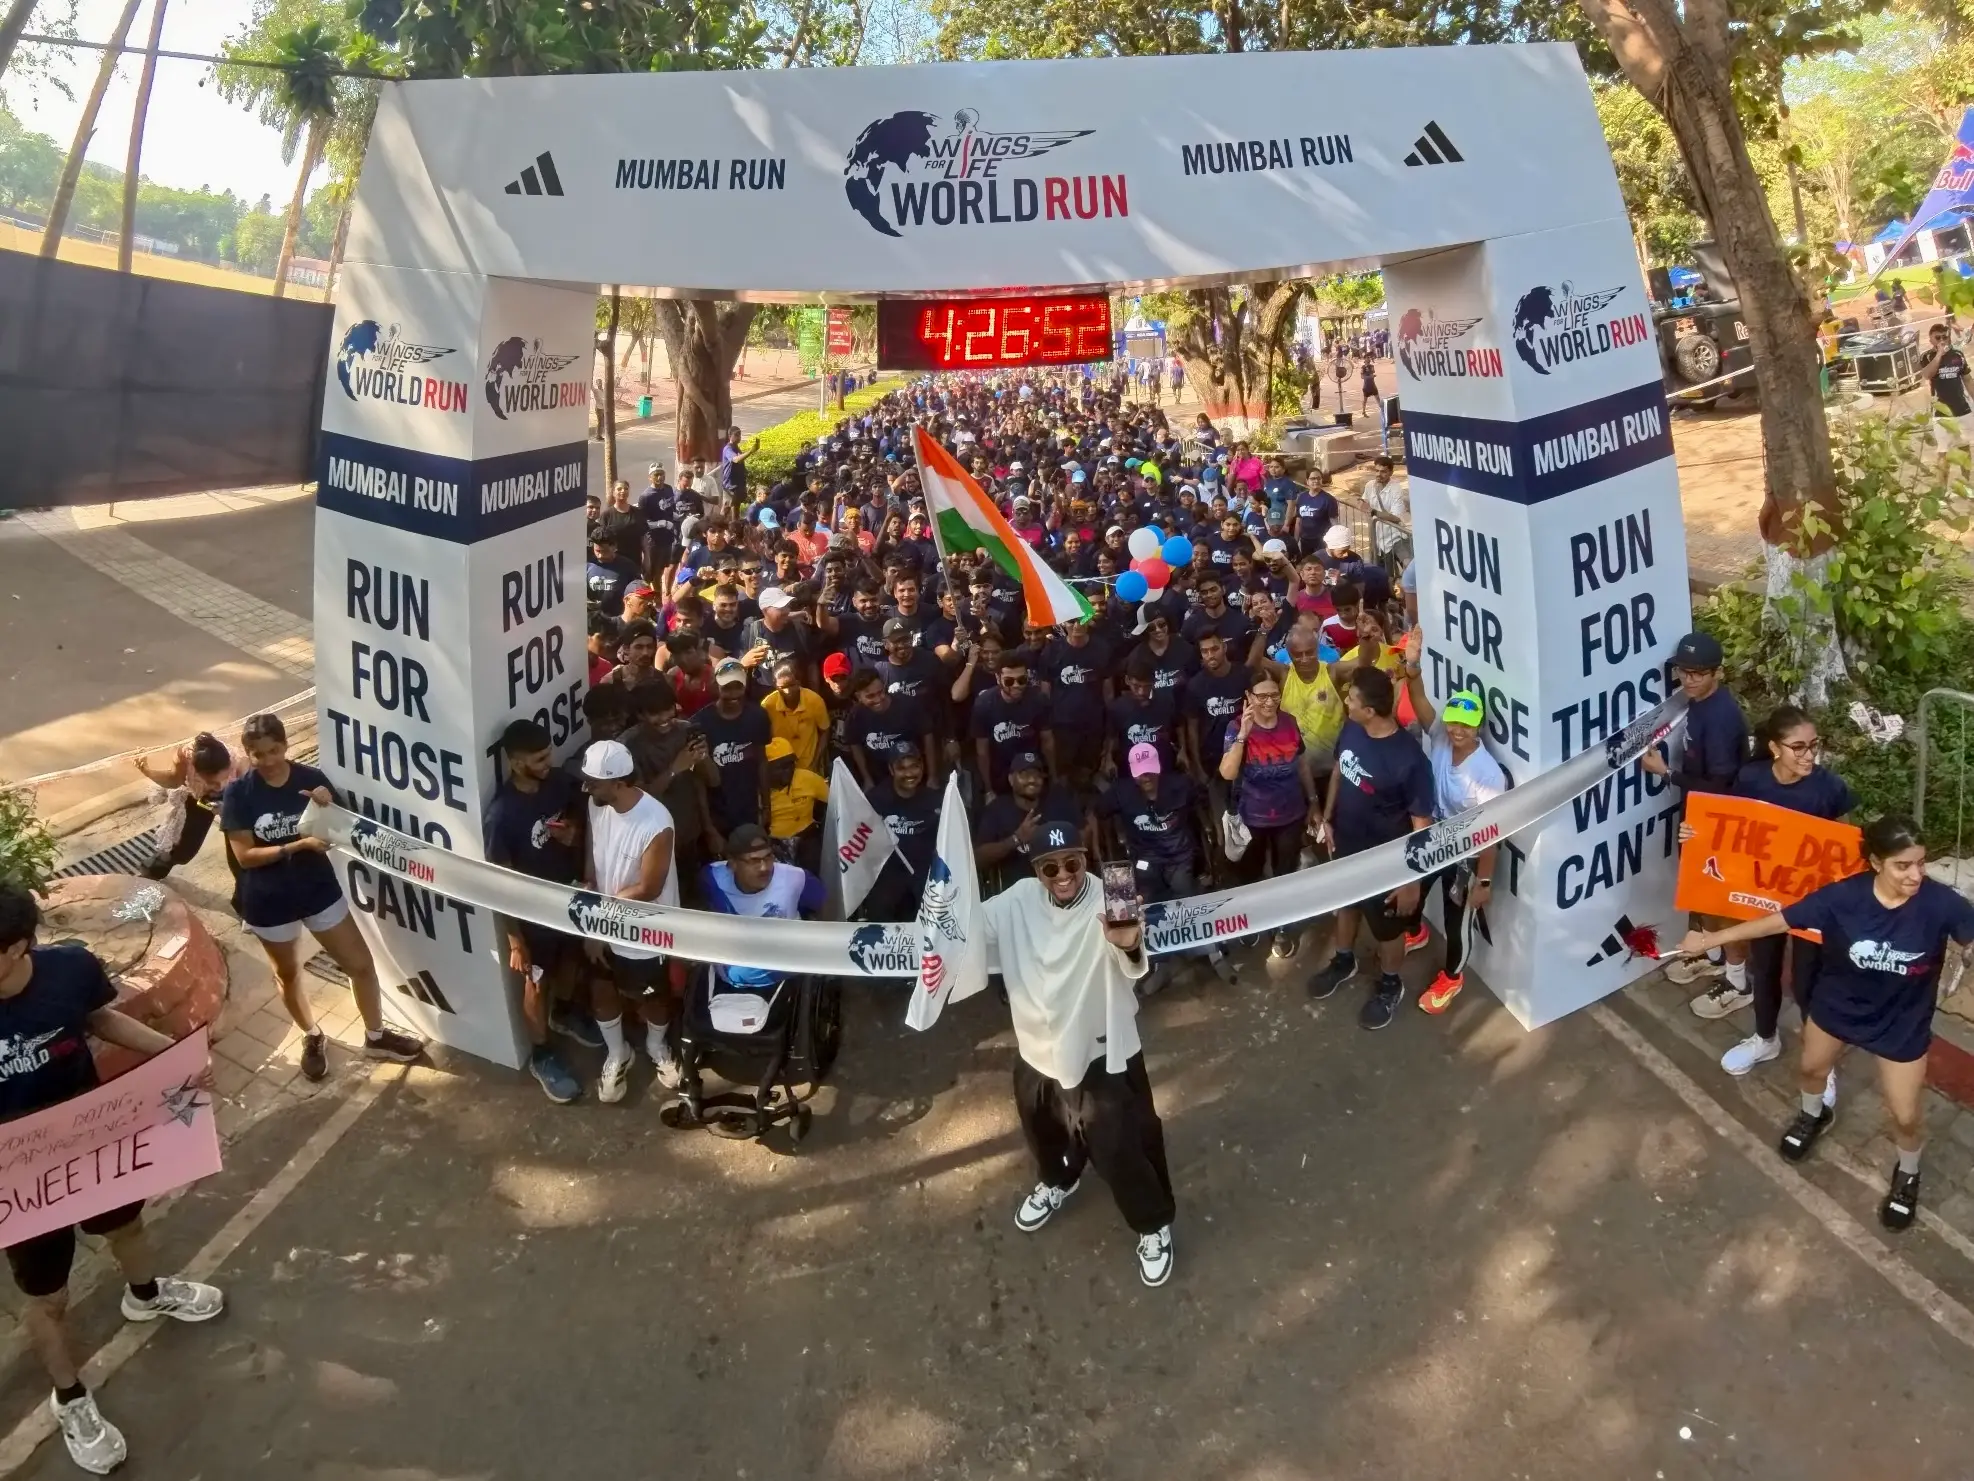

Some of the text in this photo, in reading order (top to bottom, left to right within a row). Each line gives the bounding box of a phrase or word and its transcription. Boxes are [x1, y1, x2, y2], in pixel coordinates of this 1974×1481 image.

[931, 134, 1031, 158] WINGS
[1181, 134, 1354, 176] MUMBAI RUN
[615, 158, 786, 190] MUMBAI RUN
[925, 158, 1003, 179] FOR LIFE
[1931, 168, 1974, 192] Bull
[891, 174, 1129, 226] WORLD RUN
[1553, 294, 1600, 318] WINGS
[1563, 314, 1589, 331] LIFE
[375, 340, 423, 360] WINGS
[1540, 313, 1648, 368] WORLD RUN
[522, 354, 559, 370] WINGS
[1413, 348, 1504, 378] WORLD RUN
[355, 366, 468, 414] WORLD RUN
[505, 382, 586, 414] WORLD RUN
[1410, 431, 1514, 477] MUMBAI RUN
[1533, 406, 1662, 476] MUMBAI RUN
[328, 456, 458, 517] MUMBAI RUN
[481, 461, 582, 515] MUMBAI RUN
[1434, 517, 1502, 596] RUN
[1570, 508, 1654, 598] RUN
[347, 557, 430, 642] RUN
[502, 550, 564, 633] RUN
[1443, 589, 1505, 673] FOR
[1580, 592, 1658, 677] FOR
[351, 640, 431, 724] FOR
[507, 624, 565, 710] FOR
[327, 708, 467, 813] THOSE
[721, 751, 744, 764] WORLD
[266, 825, 298, 840] WORLD
[840, 821, 873, 864] RUN
[1423, 836, 1472, 869] WORLD
[1472, 823, 1499, 848] RUN
[1705, 812, 1779, 861] THE
[364, 842, 435, 883] WORLD RUN
[1557, 803, 1681, 910] CAN'T
[347, 859, 476, 954] CAN'T
[1731, 893, 1779, 911] STRAVA
[585, 915, 674, 949] WORLD RUN
[885, 933, 915, 946] WIN
[1154, 913, 1249, 948] WORLD RUN
[869, 953, 920, 971] WORL
[1862, 959, 1908, 976] WORLD
[0, 1048, 50, 1078] WORLD
